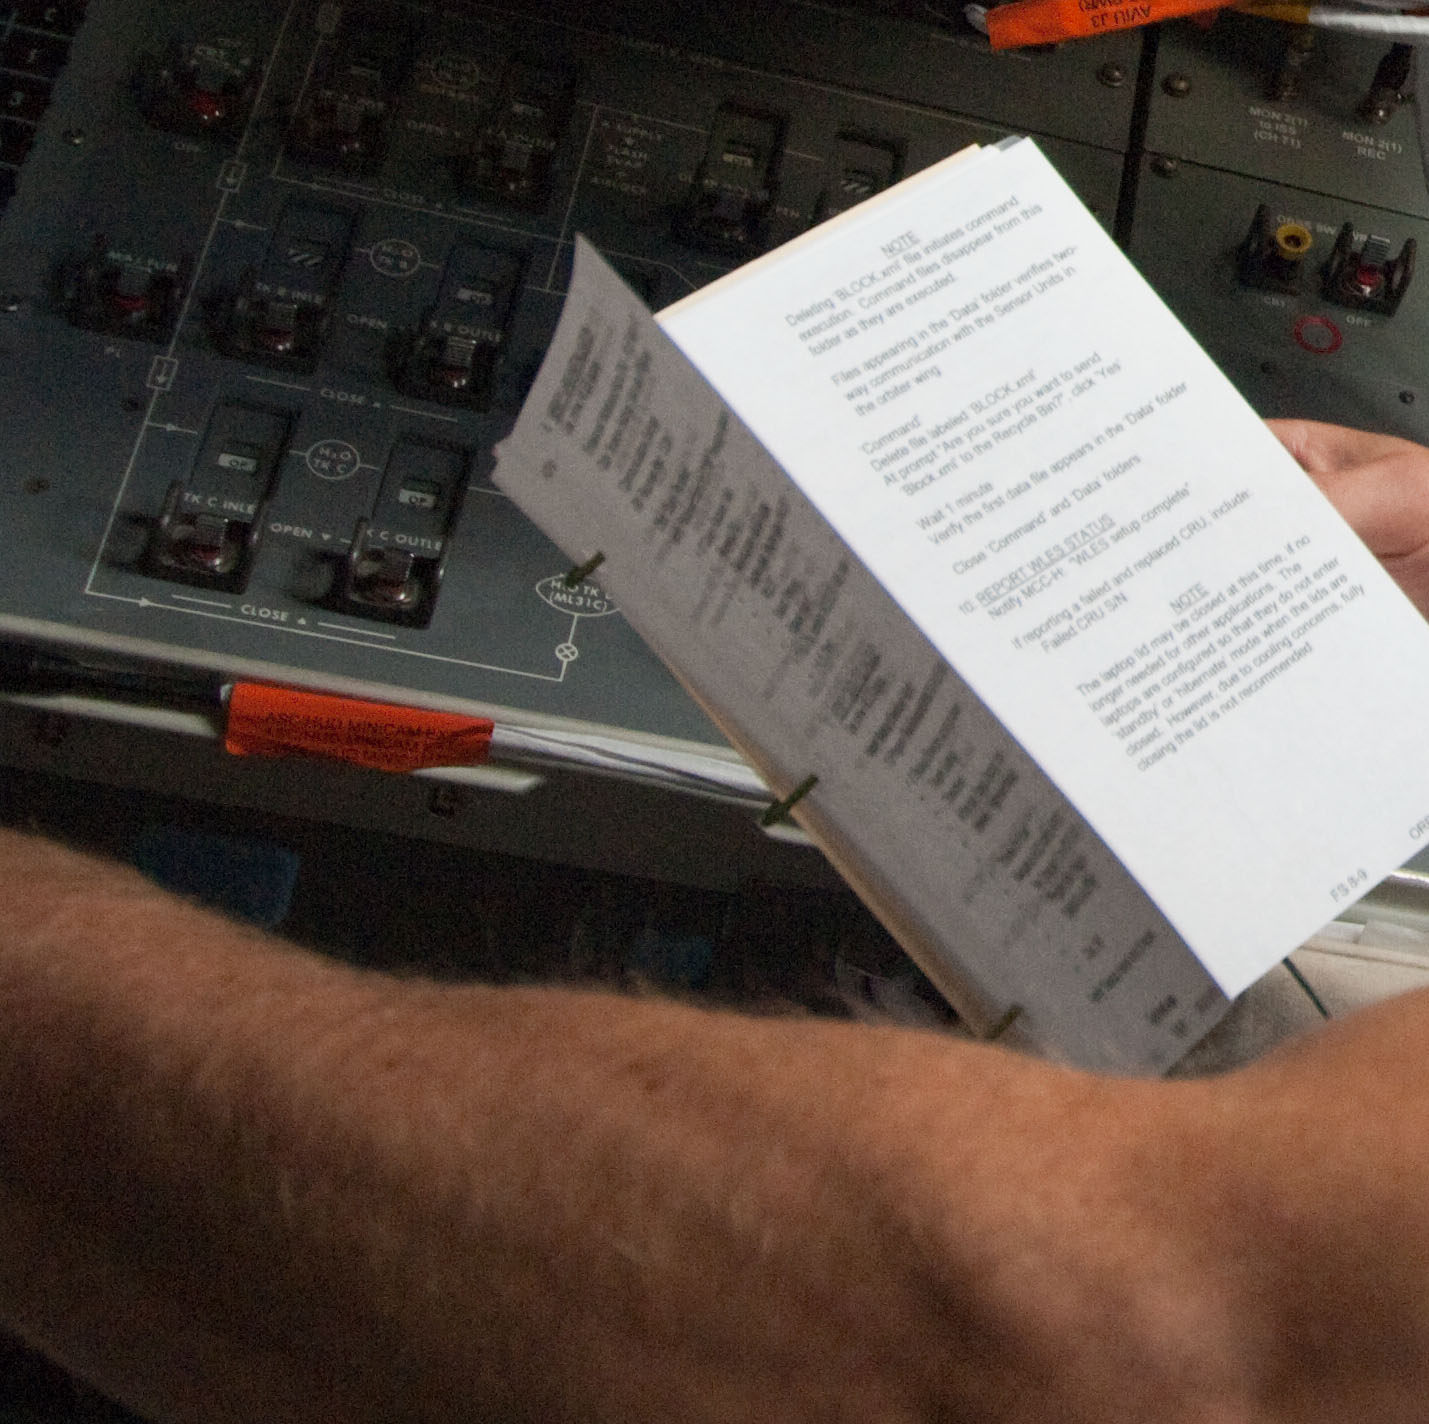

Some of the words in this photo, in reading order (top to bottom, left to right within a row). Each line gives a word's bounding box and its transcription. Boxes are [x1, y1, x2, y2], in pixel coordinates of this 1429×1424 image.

[1342, 130, 1375, 147] MON
[782, 295, 837, 329] Deleting
[899, 247, 924, 266] file
[917, 224, 967, 256] initiates
[961, 195, 1023, 232] command
[878, 229, 922, 258] NOTE
[806, 332, 845, 358] folder
[841, 325, 860, 340] as
[855, 309, 887, 333] they
[882, 300, 906, 318] are
[829, 363, 863, 387] Files
[859, 335, 920, 373] appearing
[914, 327, 931, 341] in
[926, 315, 952, 335] the
[978, 279, 1017, 306] folder
[1010, 256, 1056, 286] verifies
[842, 382, 872, 404] way
[866, 336, 954, 389] communication
[948, 321, 977, 343] with
[972, 311, 997, 330] the
[991, 288, 1036, 318] Sensor
[1030, 271, 1066, 295] Units
[1061, 263, 1079, 277] in
[866, 442, 912, 474] Delete
[906, 432, 930, 452] file
[924, 408, 972, 441] labeled
[182, 491, 203, 505] TK
[268, 520, 314, 539] OPEN
[950, 547, 989, 576] Close
[1045, 495, 1075, 518] and
[1099, 451, 1144, 483] folders
[973, 565, 1031, 608] REPORT
[1024, 542, 1068, 575] WLES
[1061, 511, 1116, 552] STATUS
[986, 591, 1025, 622] Notify
[1106, 515, 1143, 545] setup
[238, 602, 290, 623] CLOSE
[1008, 636, 1025, 652] If
[1020, 606, 1074, 646] reporting
[1069, 601, 1083, 614] a
[1077, 579, 1114, 607] failed
[1108, 565, 1136, 587] and
[1130, 534, 1183, 573] replaced
[1039, 623, 1079, 654] Failed
[1073, 604, 1108, 632] CRU
[1101, 589, 1130, 613] S/N
[1166, 581, 1211, 616] NOTE
[1098, 692, 1145, 730] laptops
[1138, 680, 1164, 702] are
[1157, 641, 1220, 689] configured
[1213, 630, 1235, 650] so
[1228, 614, 1257, 639] that
[1250, 598, 1281, 623] they
[1274, 586, 1296, 607] do
[1290, 573, 1315, 596] not
[1309, 555, 1342, 581] enter
[1327, 881, 1352, 906] FS
[1345, 866, 1371, 890] 8-9
